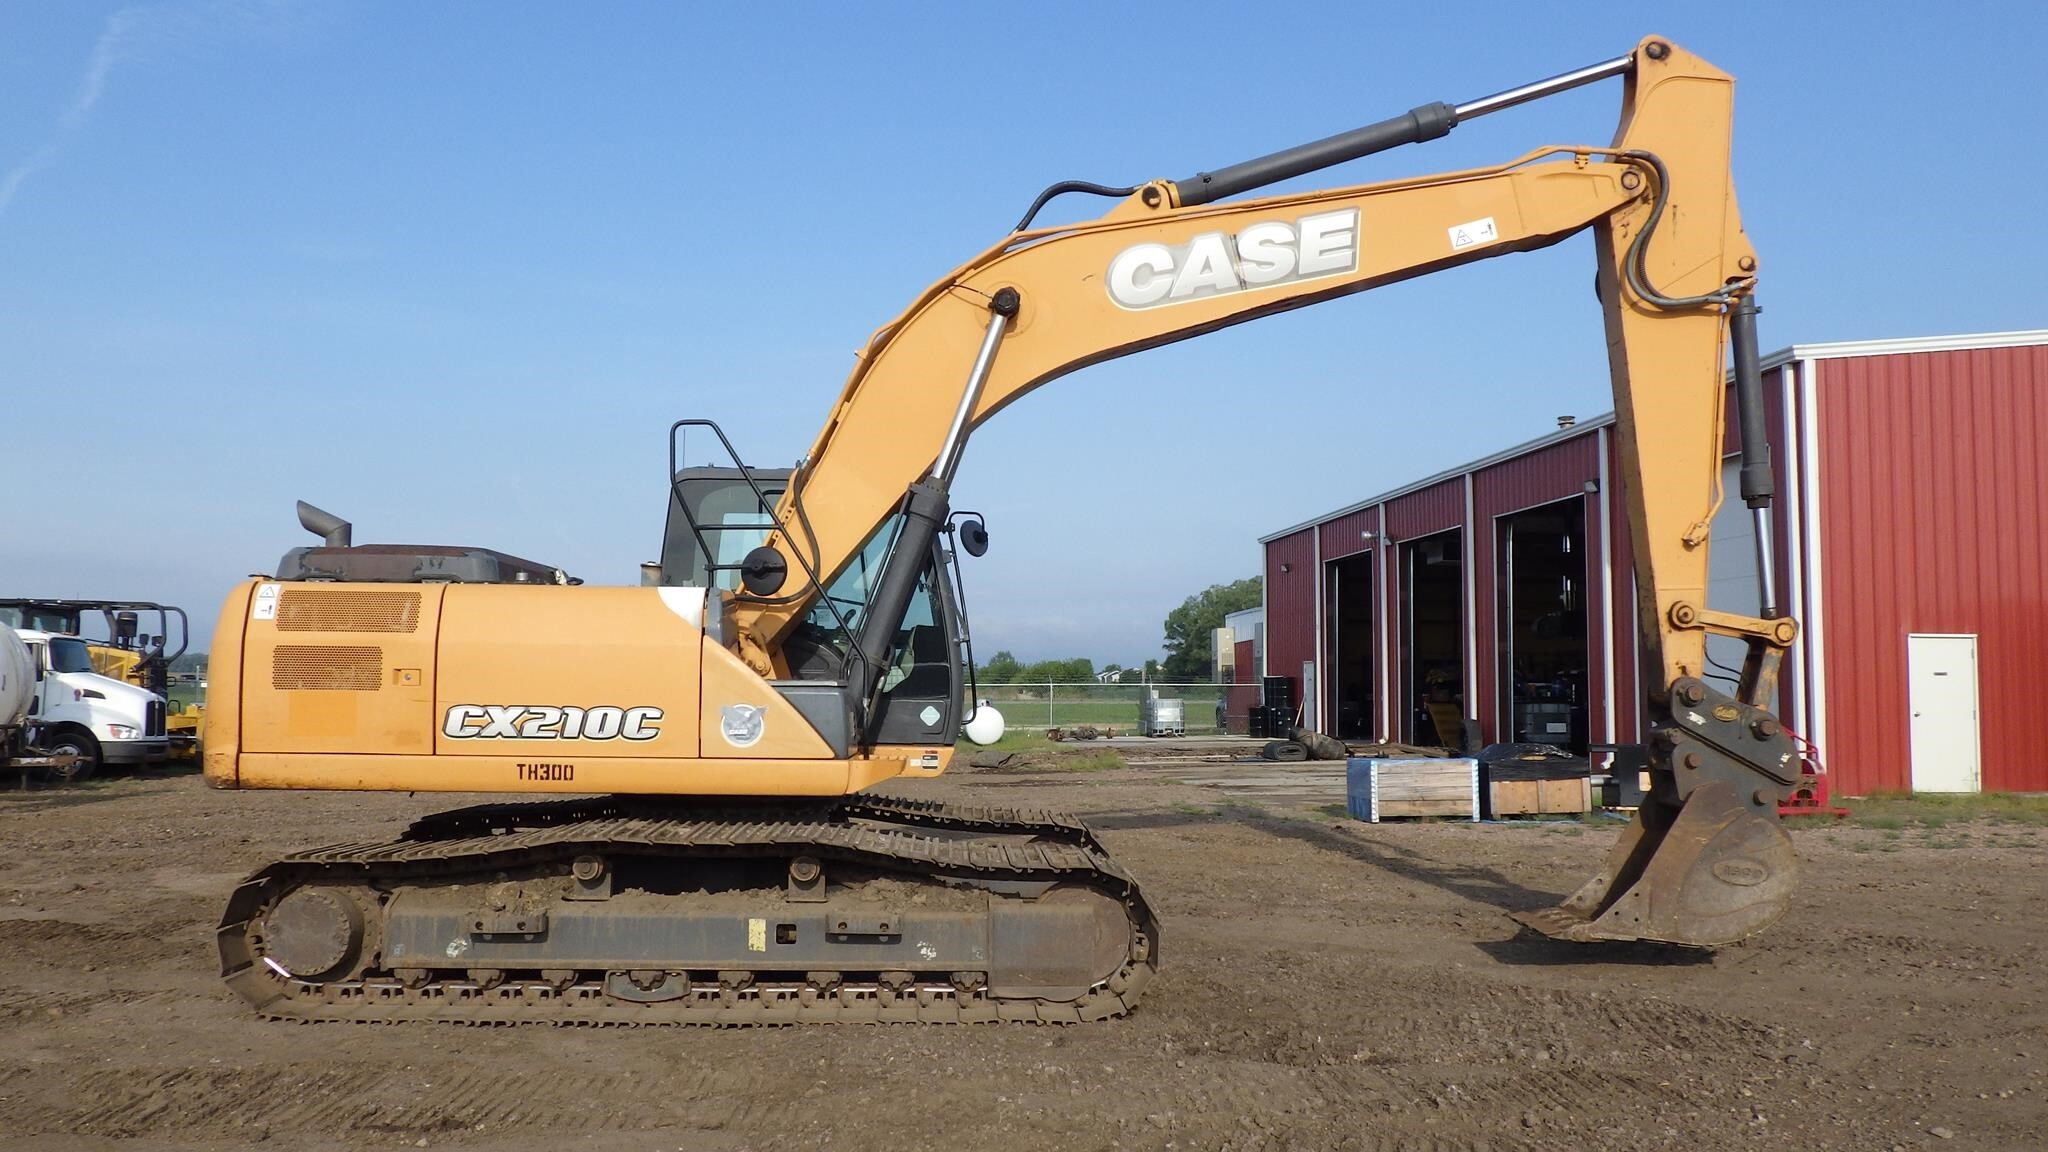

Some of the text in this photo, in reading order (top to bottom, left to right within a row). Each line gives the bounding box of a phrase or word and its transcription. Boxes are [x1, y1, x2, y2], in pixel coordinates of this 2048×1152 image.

[1108, 210, 1358, 307] CASE
[443, 704, 664, 740] CX210C
[516, 763, 574, 781] TH300
